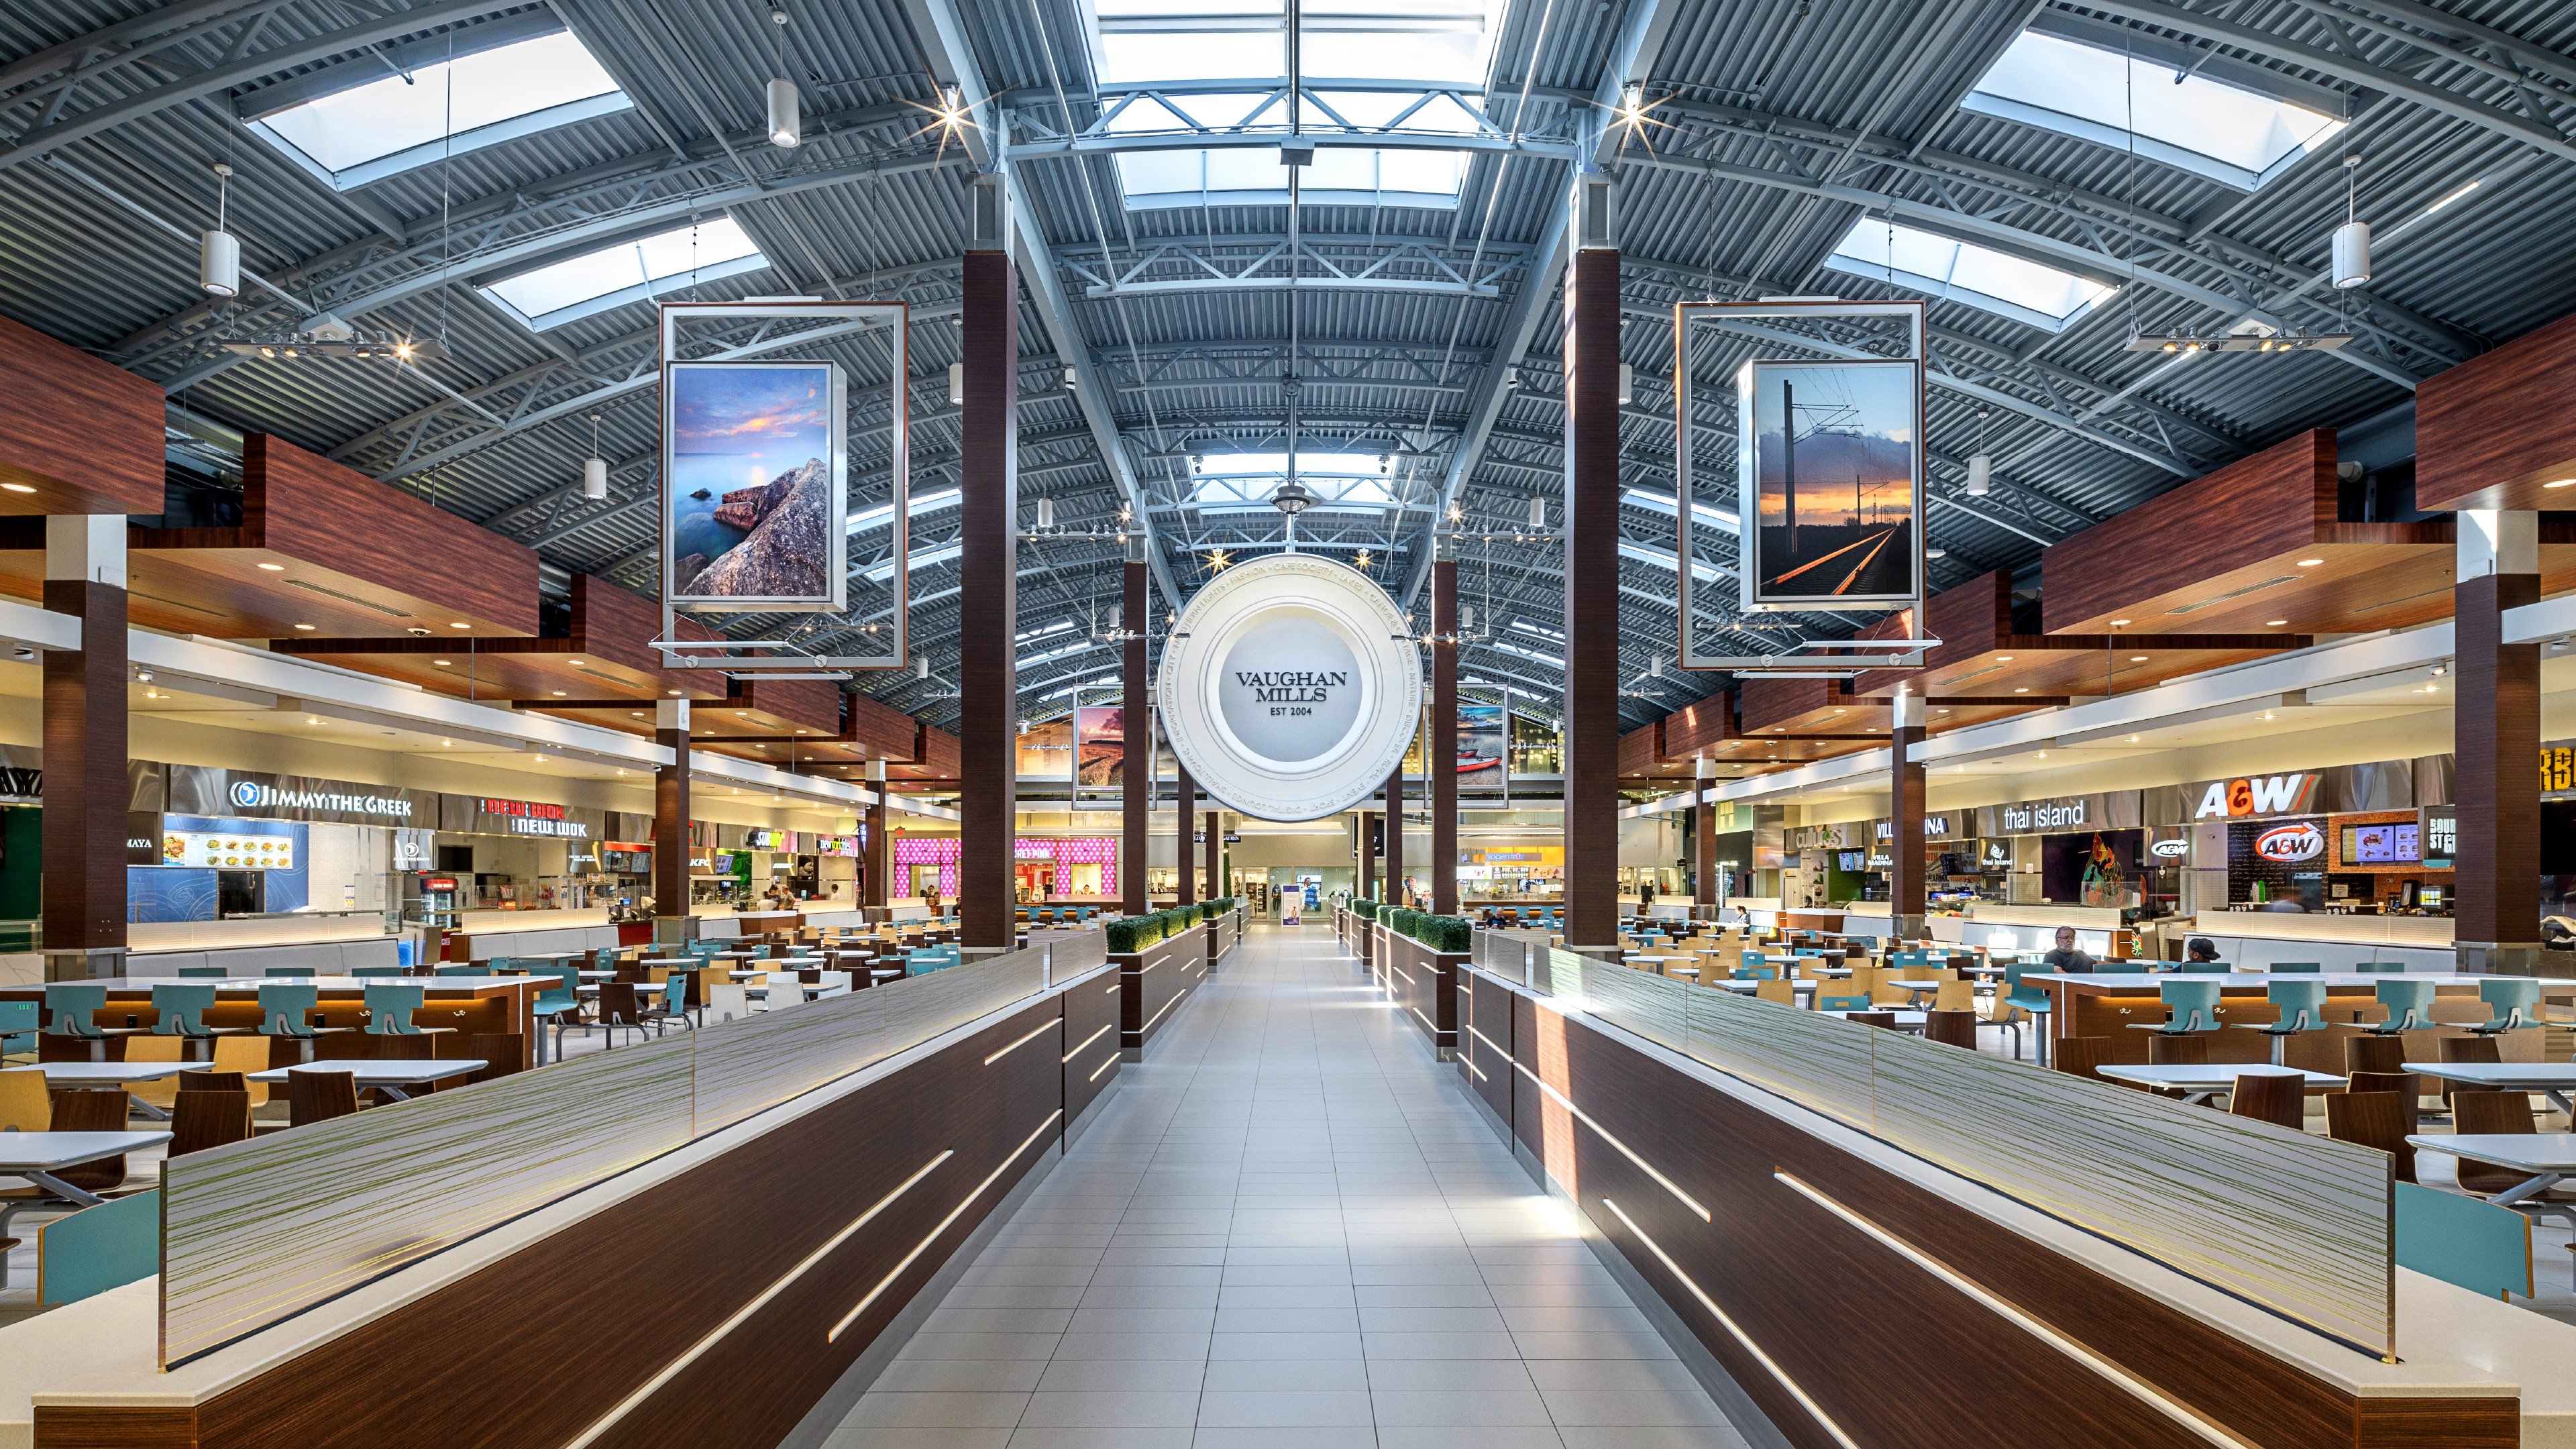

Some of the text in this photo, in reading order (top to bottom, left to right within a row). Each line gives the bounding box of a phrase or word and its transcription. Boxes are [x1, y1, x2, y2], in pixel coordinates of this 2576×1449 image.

[1231, 566, 1267, 584] FASHION
[1297, 561, 1333, 577] SOCIETY
[1338, 572, 1363, 591] LAKES
[1235, 672, 1348, 687] VAUGHAN
[1255, 687, 1328, 703] MILLS
[1407, 672, 1416, 710] NATURE
[1270, 707, 1312, 716] EST 2004
[1391, 714, 1415, 754] DISCOVER
[261, 785, 412, 816] JIMMY THE GREEK
[2194, 773, 2303, 819] A&W
[530, 803, 566, 820] WOK
[2004, 800, 2084, 830] thai island
[557, 821, 588, 837] WOK
[2157, 845, 2189, 855] A&W
[2262, 837, 2314, 855] A&W
[689, 858, 712, 867] KFC
[1487, 854, 1510, 862] yogen
